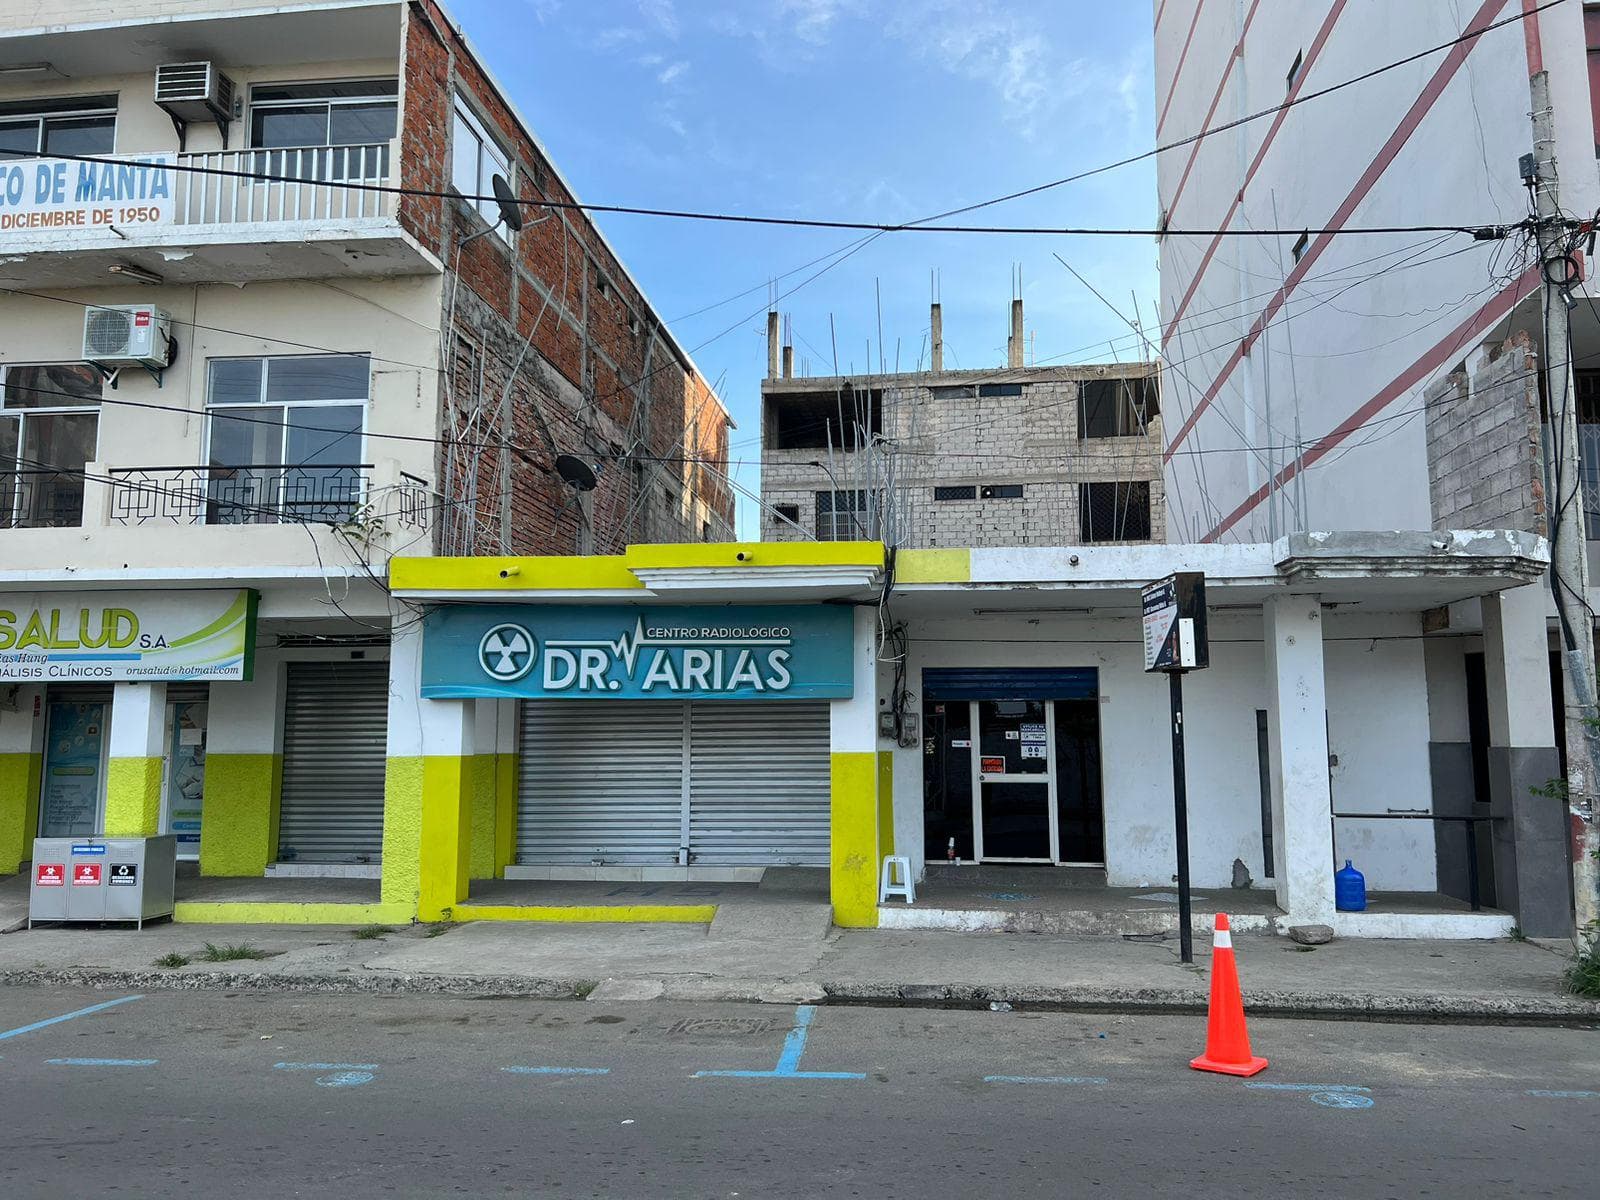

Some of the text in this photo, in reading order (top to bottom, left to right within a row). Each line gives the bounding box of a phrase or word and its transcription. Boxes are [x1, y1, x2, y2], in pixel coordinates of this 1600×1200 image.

[35, 162, 67, 204] DE
[75, 157, 168, 201] MANTA
[1, 206, 160, 229] DICIEMBRE DE 1950
[646, 626, 791, 638] CENTRO RADIOLOGICO
[140, 634, 170, 649] S.A.
[18, 653, 48, 664] Hung
[0, 664, 42, 678] ÁLISIS
[543, 649, 792, 691] DR. ARIAS
